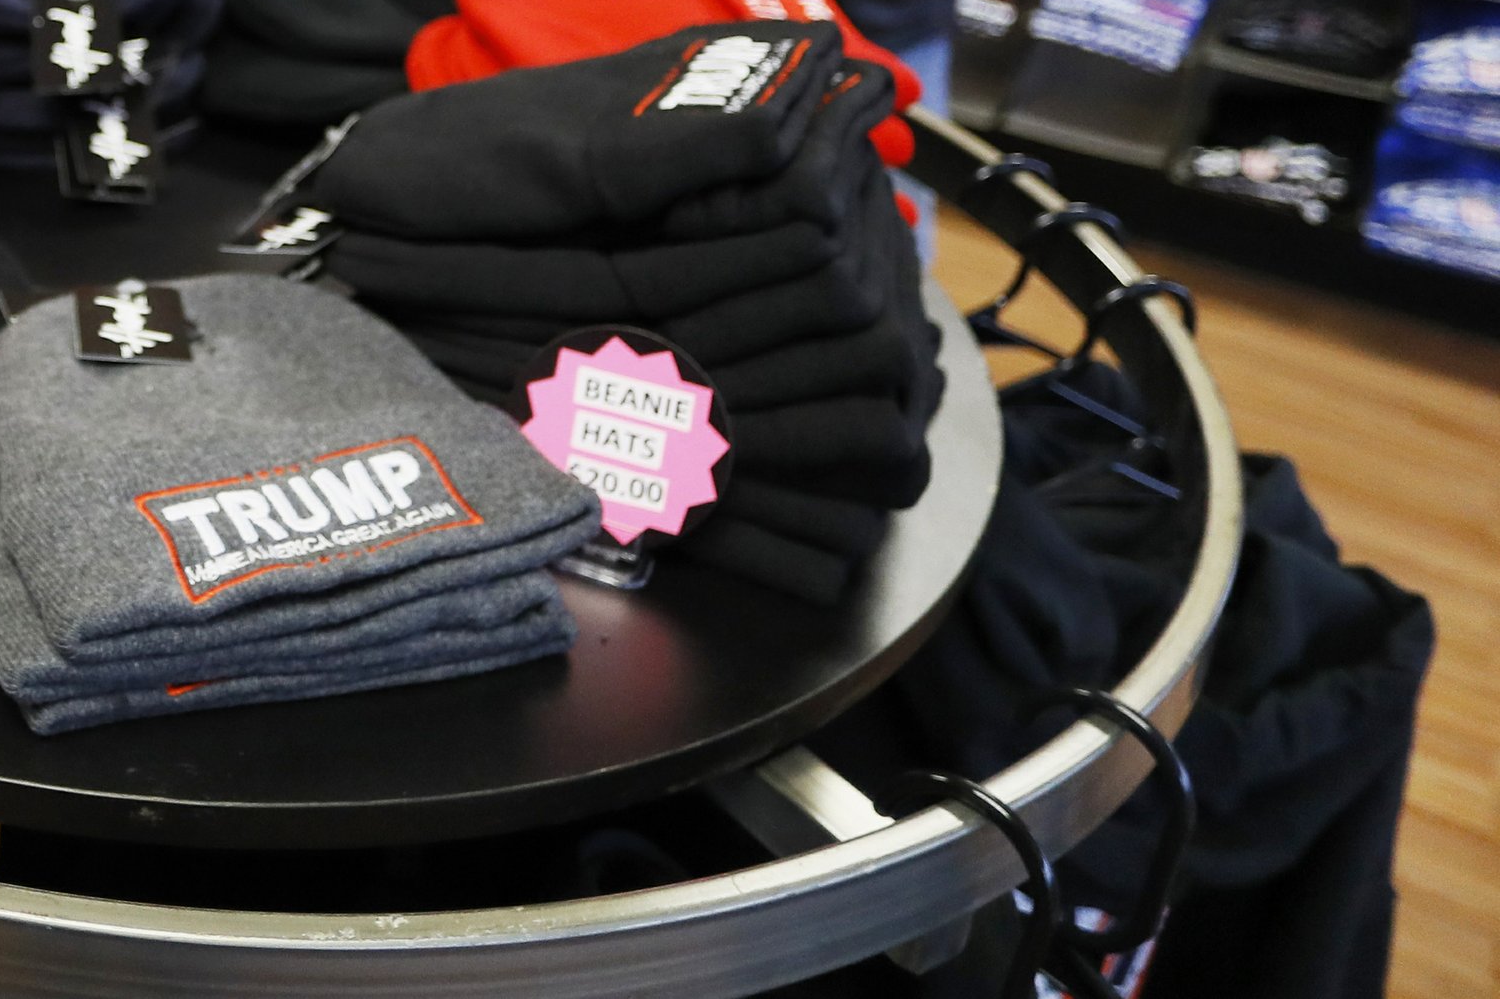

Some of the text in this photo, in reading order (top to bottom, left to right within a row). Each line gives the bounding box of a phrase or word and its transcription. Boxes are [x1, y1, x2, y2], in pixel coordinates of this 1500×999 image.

[585, 379, 689, 424] BEANIE
[582, 422, 655, 460] HATS
[161, 450, 421, 557] TRUMP
